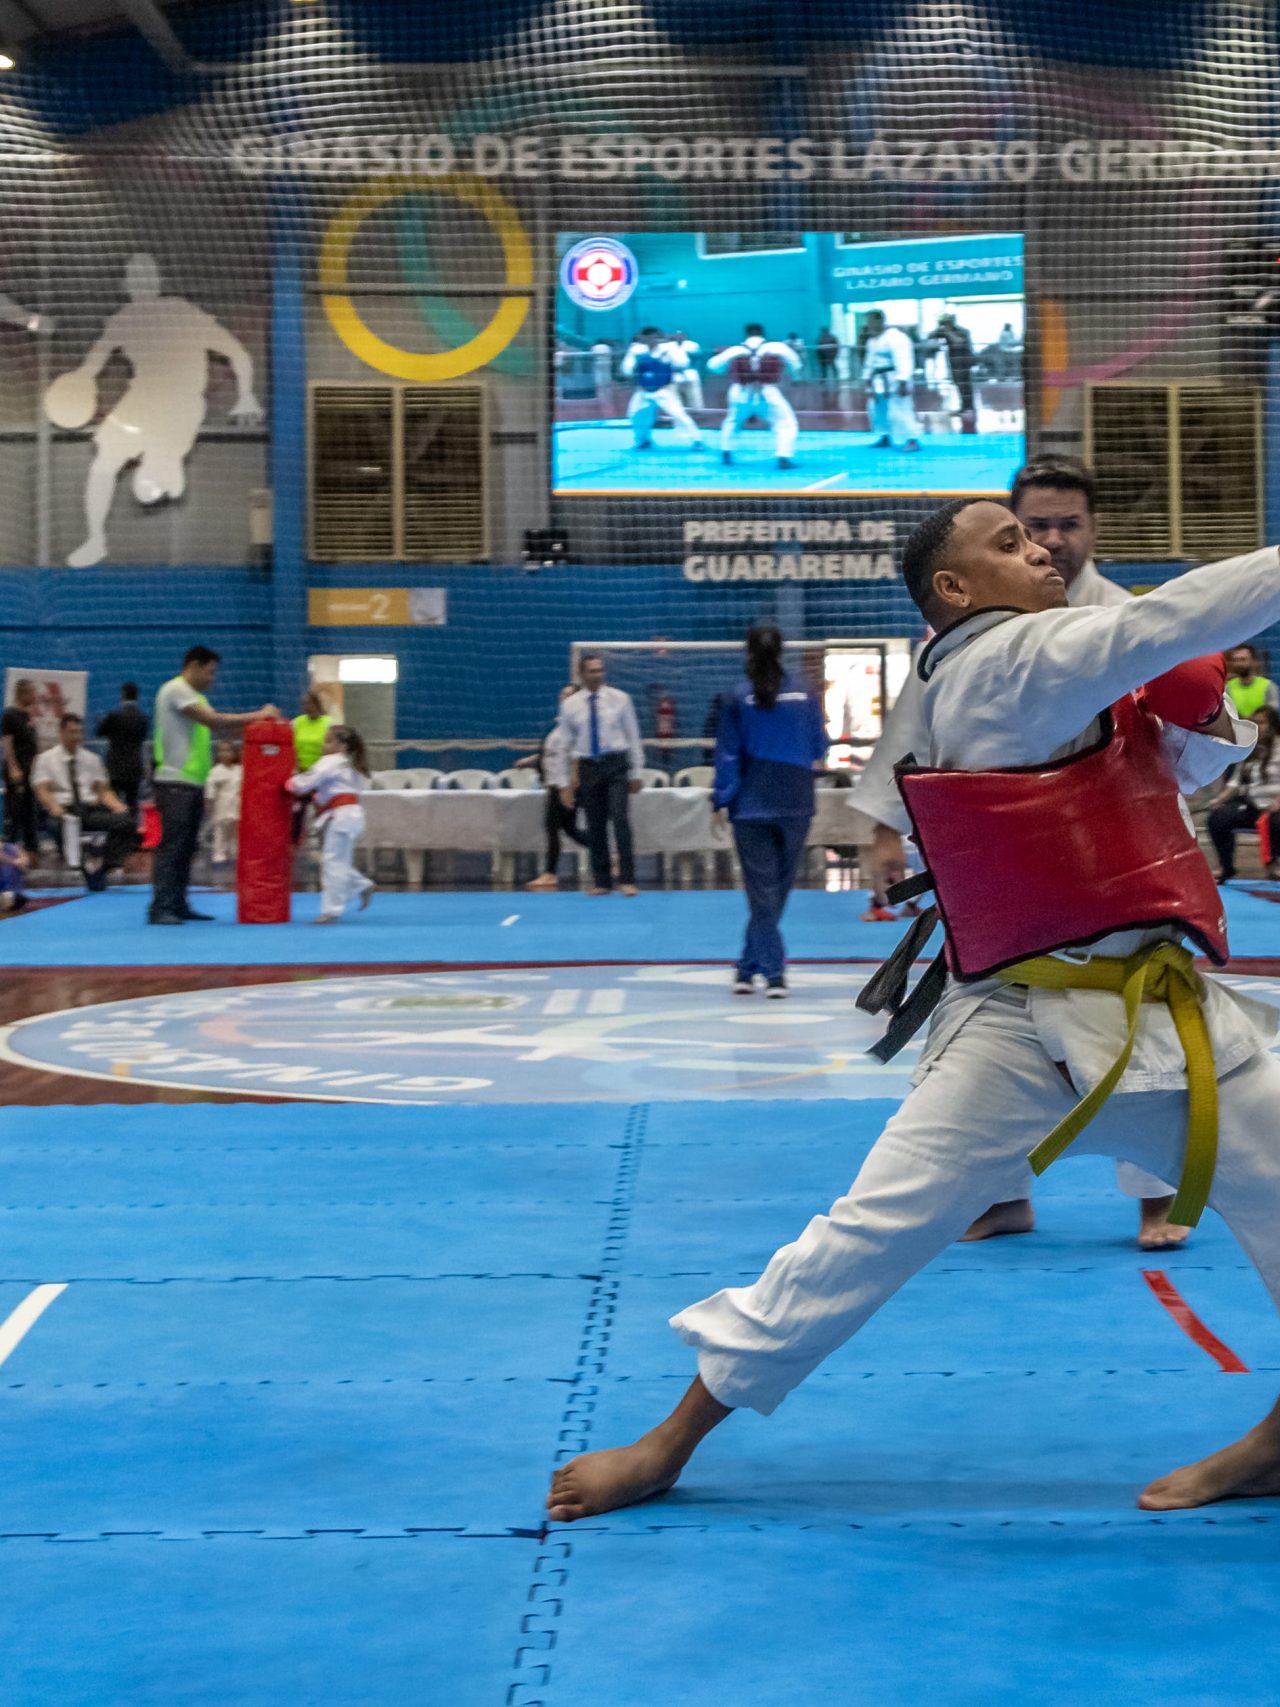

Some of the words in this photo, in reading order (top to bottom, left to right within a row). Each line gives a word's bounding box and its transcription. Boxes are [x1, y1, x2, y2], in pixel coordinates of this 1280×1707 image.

[472, 133, 541, 177] DE
[561, 136, 814, 179] ESPORTES
[683, 520, 851, 542] PREFEITURA
[859, 520, 896, 541] DE
[683, 554, 898, 581] GUARAREMA
[369, 593, 391, 620] 2
